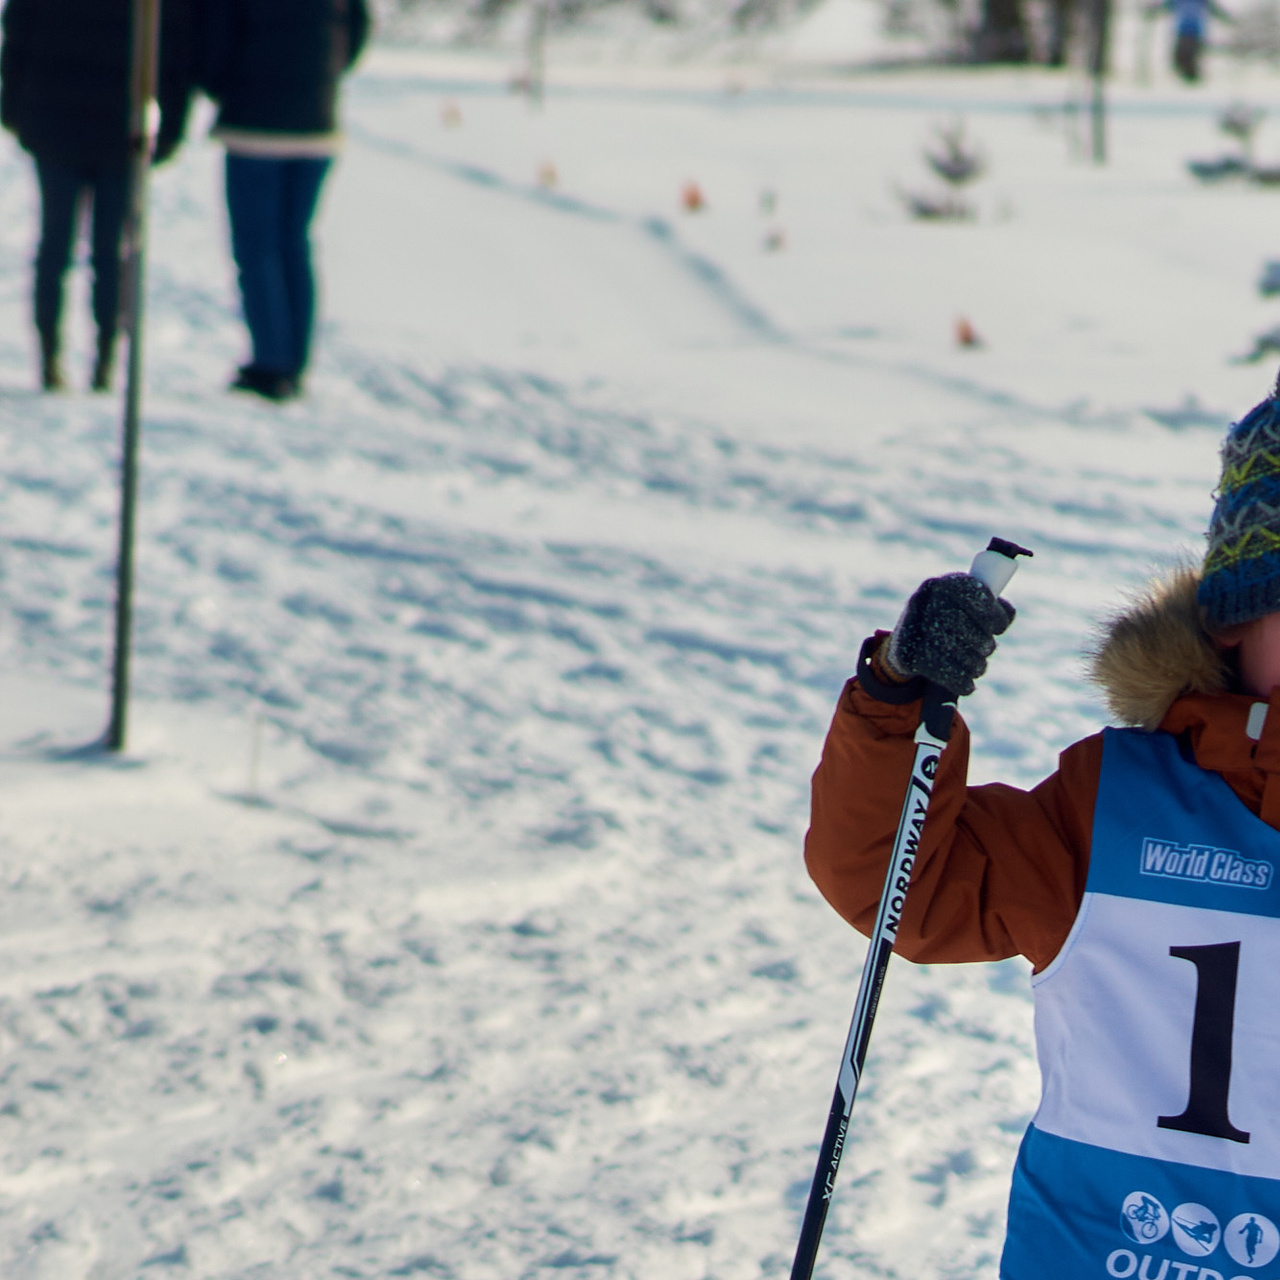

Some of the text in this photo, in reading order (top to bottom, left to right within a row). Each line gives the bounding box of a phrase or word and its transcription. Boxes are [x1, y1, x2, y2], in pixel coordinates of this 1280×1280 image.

[885, 798, 928, 935] NORDWAY
[1145, 843, 1269, 886] World Class
[831, 1119, 849, 1170] ACTIVE
